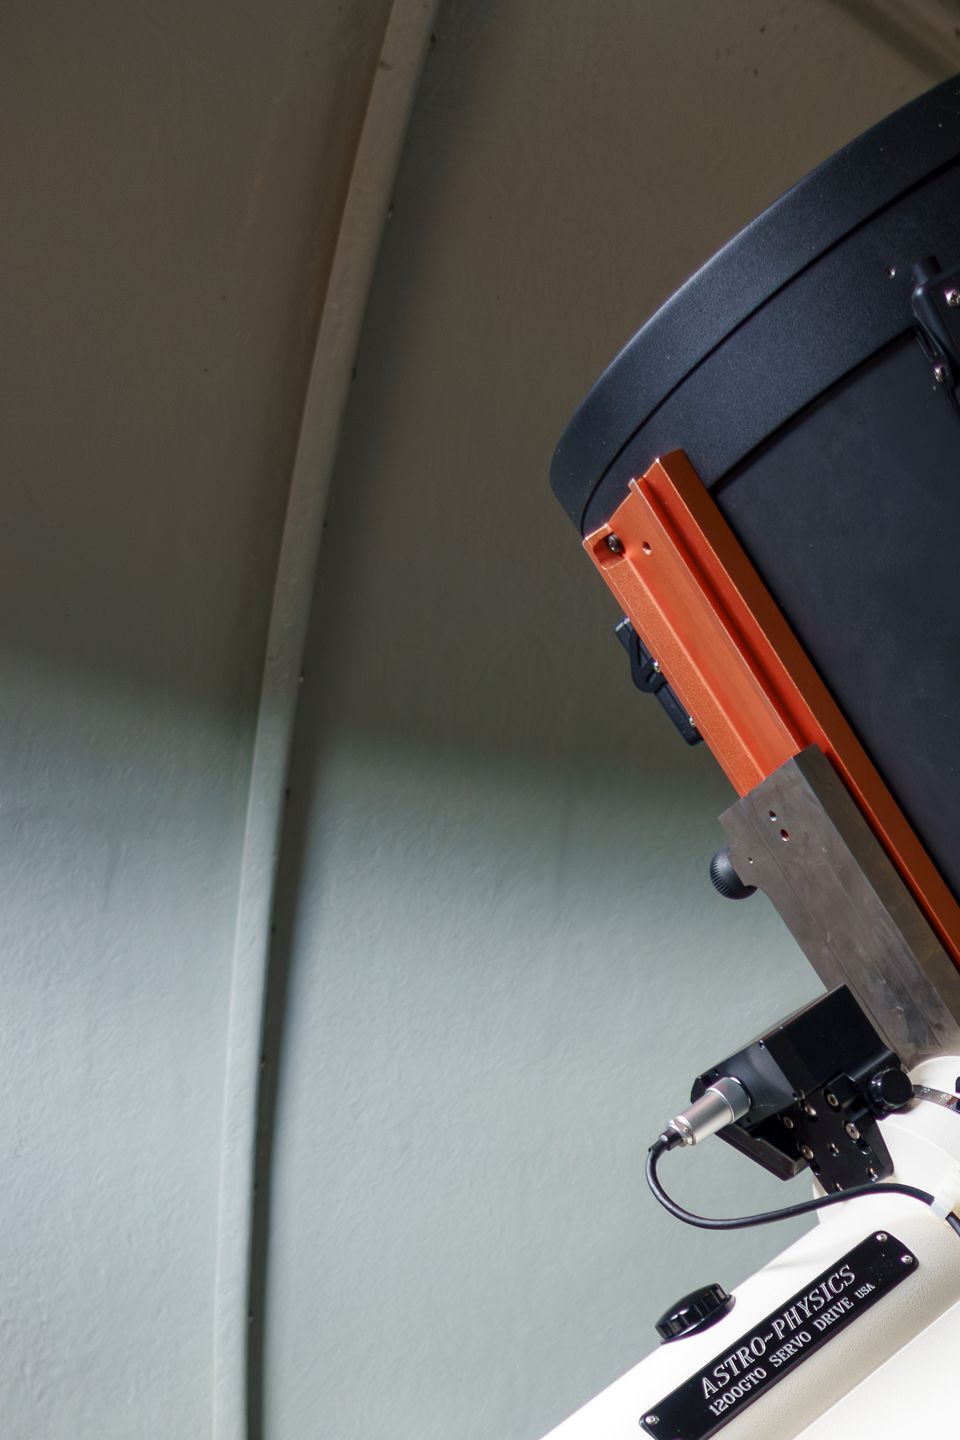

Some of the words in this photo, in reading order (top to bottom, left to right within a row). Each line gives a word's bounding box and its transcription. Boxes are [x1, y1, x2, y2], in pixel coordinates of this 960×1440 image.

[708, 1366, 767, 1416] 1200GTO
[768, 1331, 812, 1368] SERVO
[813, 1297, 854, 1332] DRIVE
[855, 1283, 875, 1299] USA
